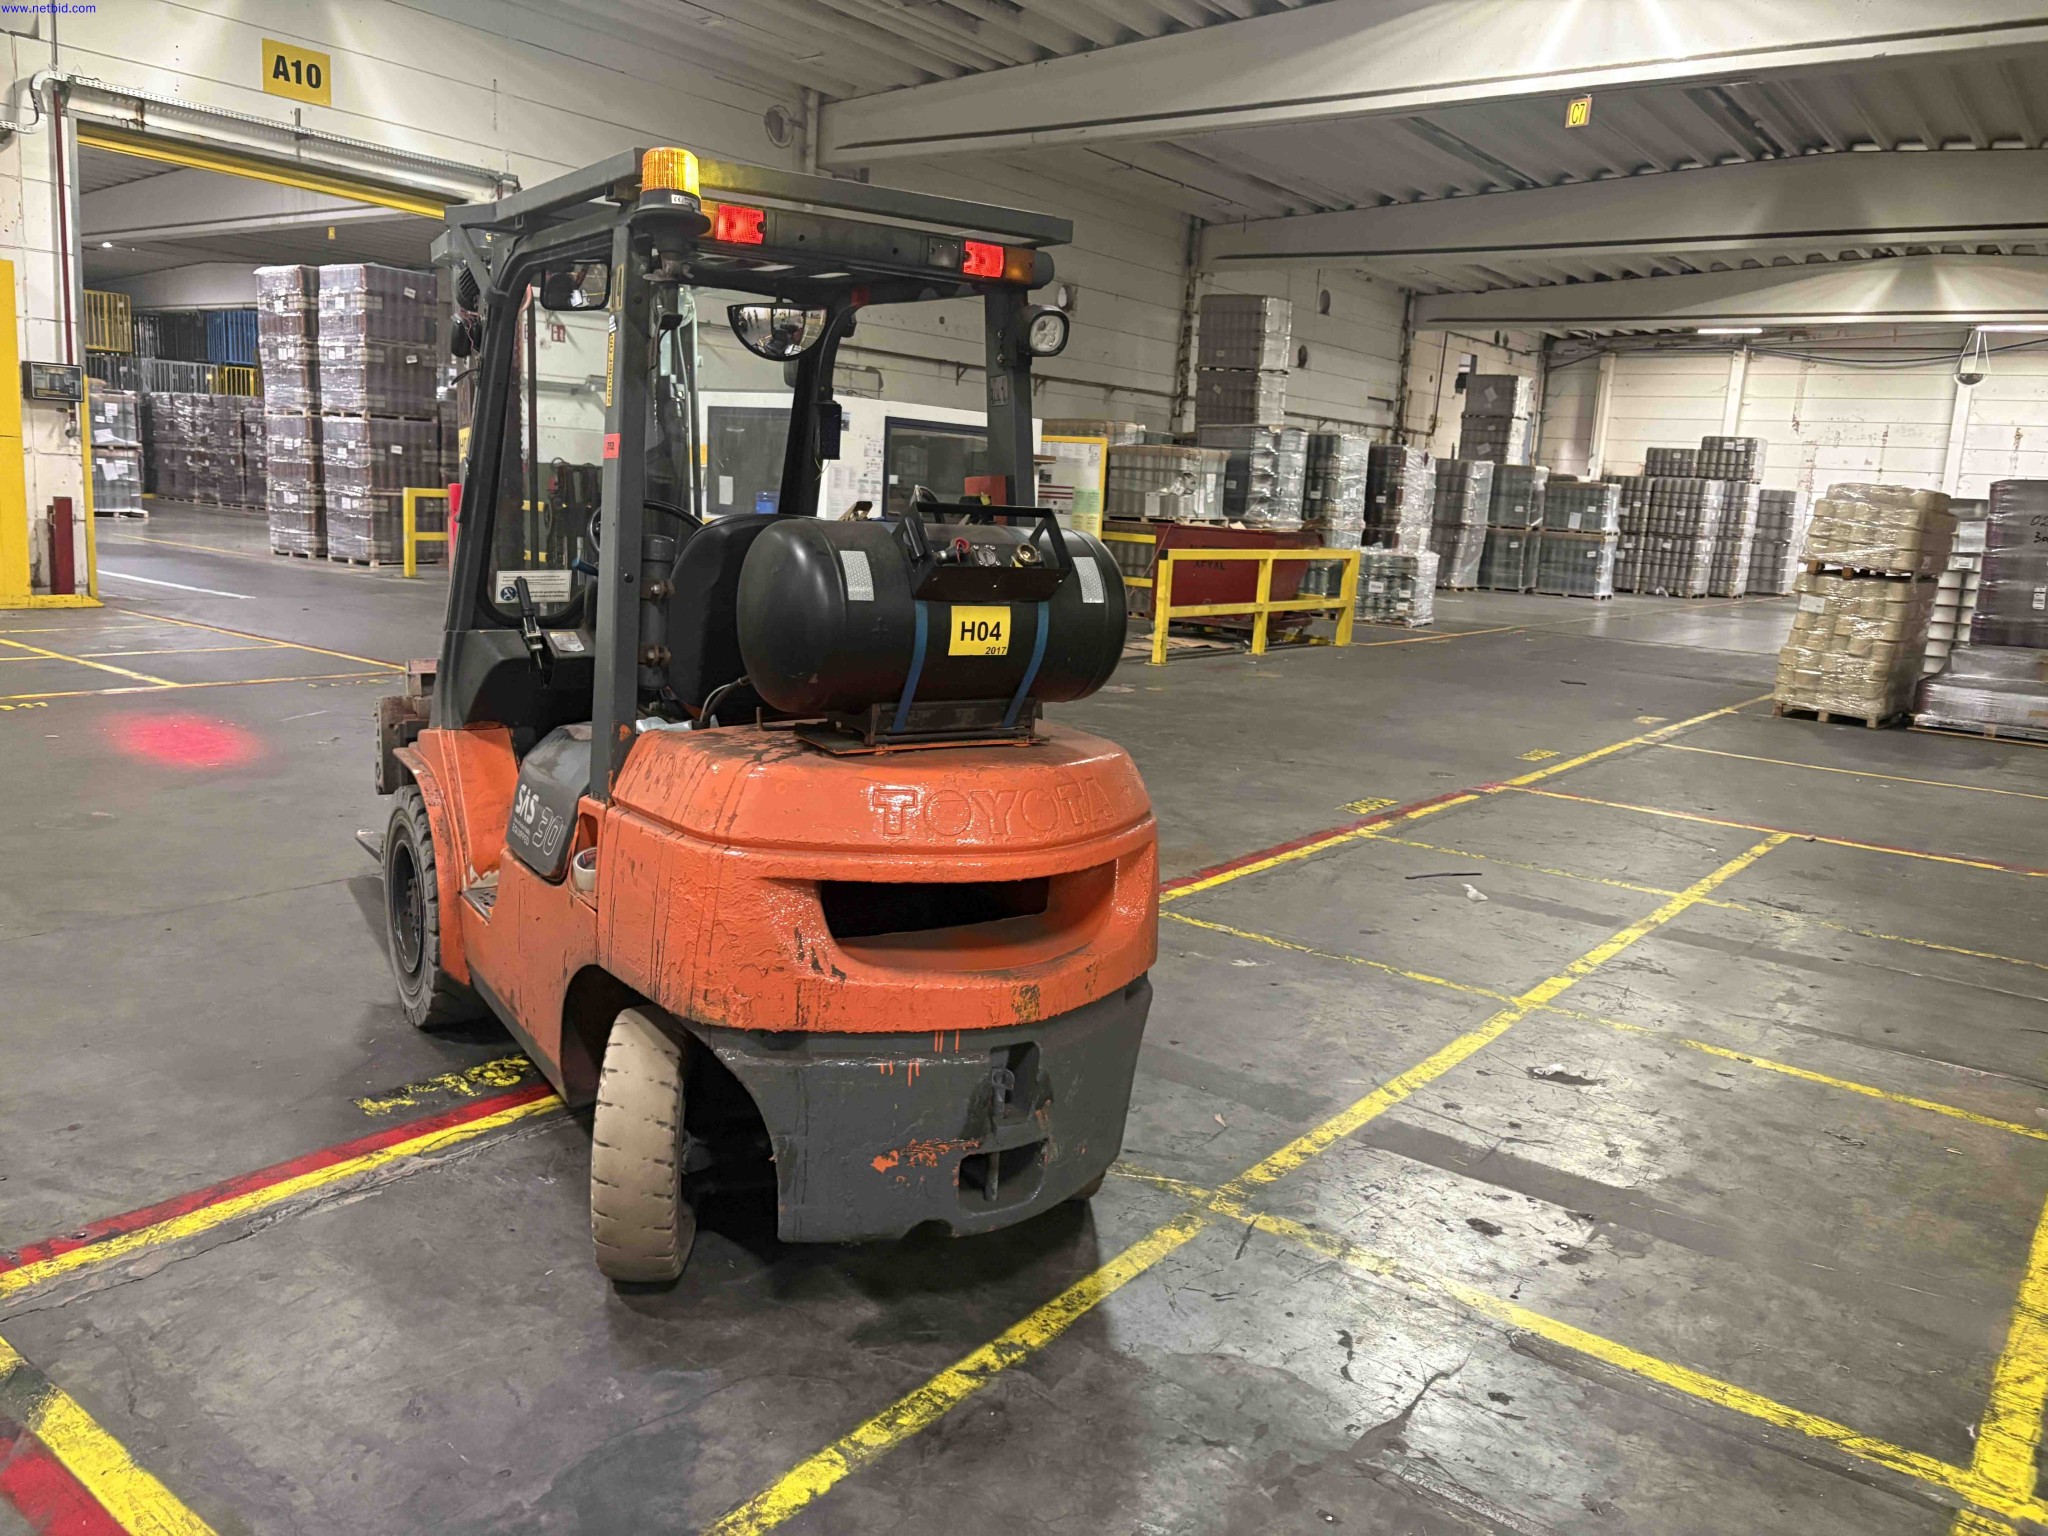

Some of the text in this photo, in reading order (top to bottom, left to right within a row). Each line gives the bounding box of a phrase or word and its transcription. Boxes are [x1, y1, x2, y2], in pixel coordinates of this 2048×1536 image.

[272, 54, 322, 89] A10
[1571, 103, 1586, 124] C7
[960, 620, 1002, 642] H04
[985, 646, 1007, 655] 2017
[515, 783, 540, 825] SAS
[872, 777, 1115, 837] TOYOTA
[532, 806, 564, 856] 30
